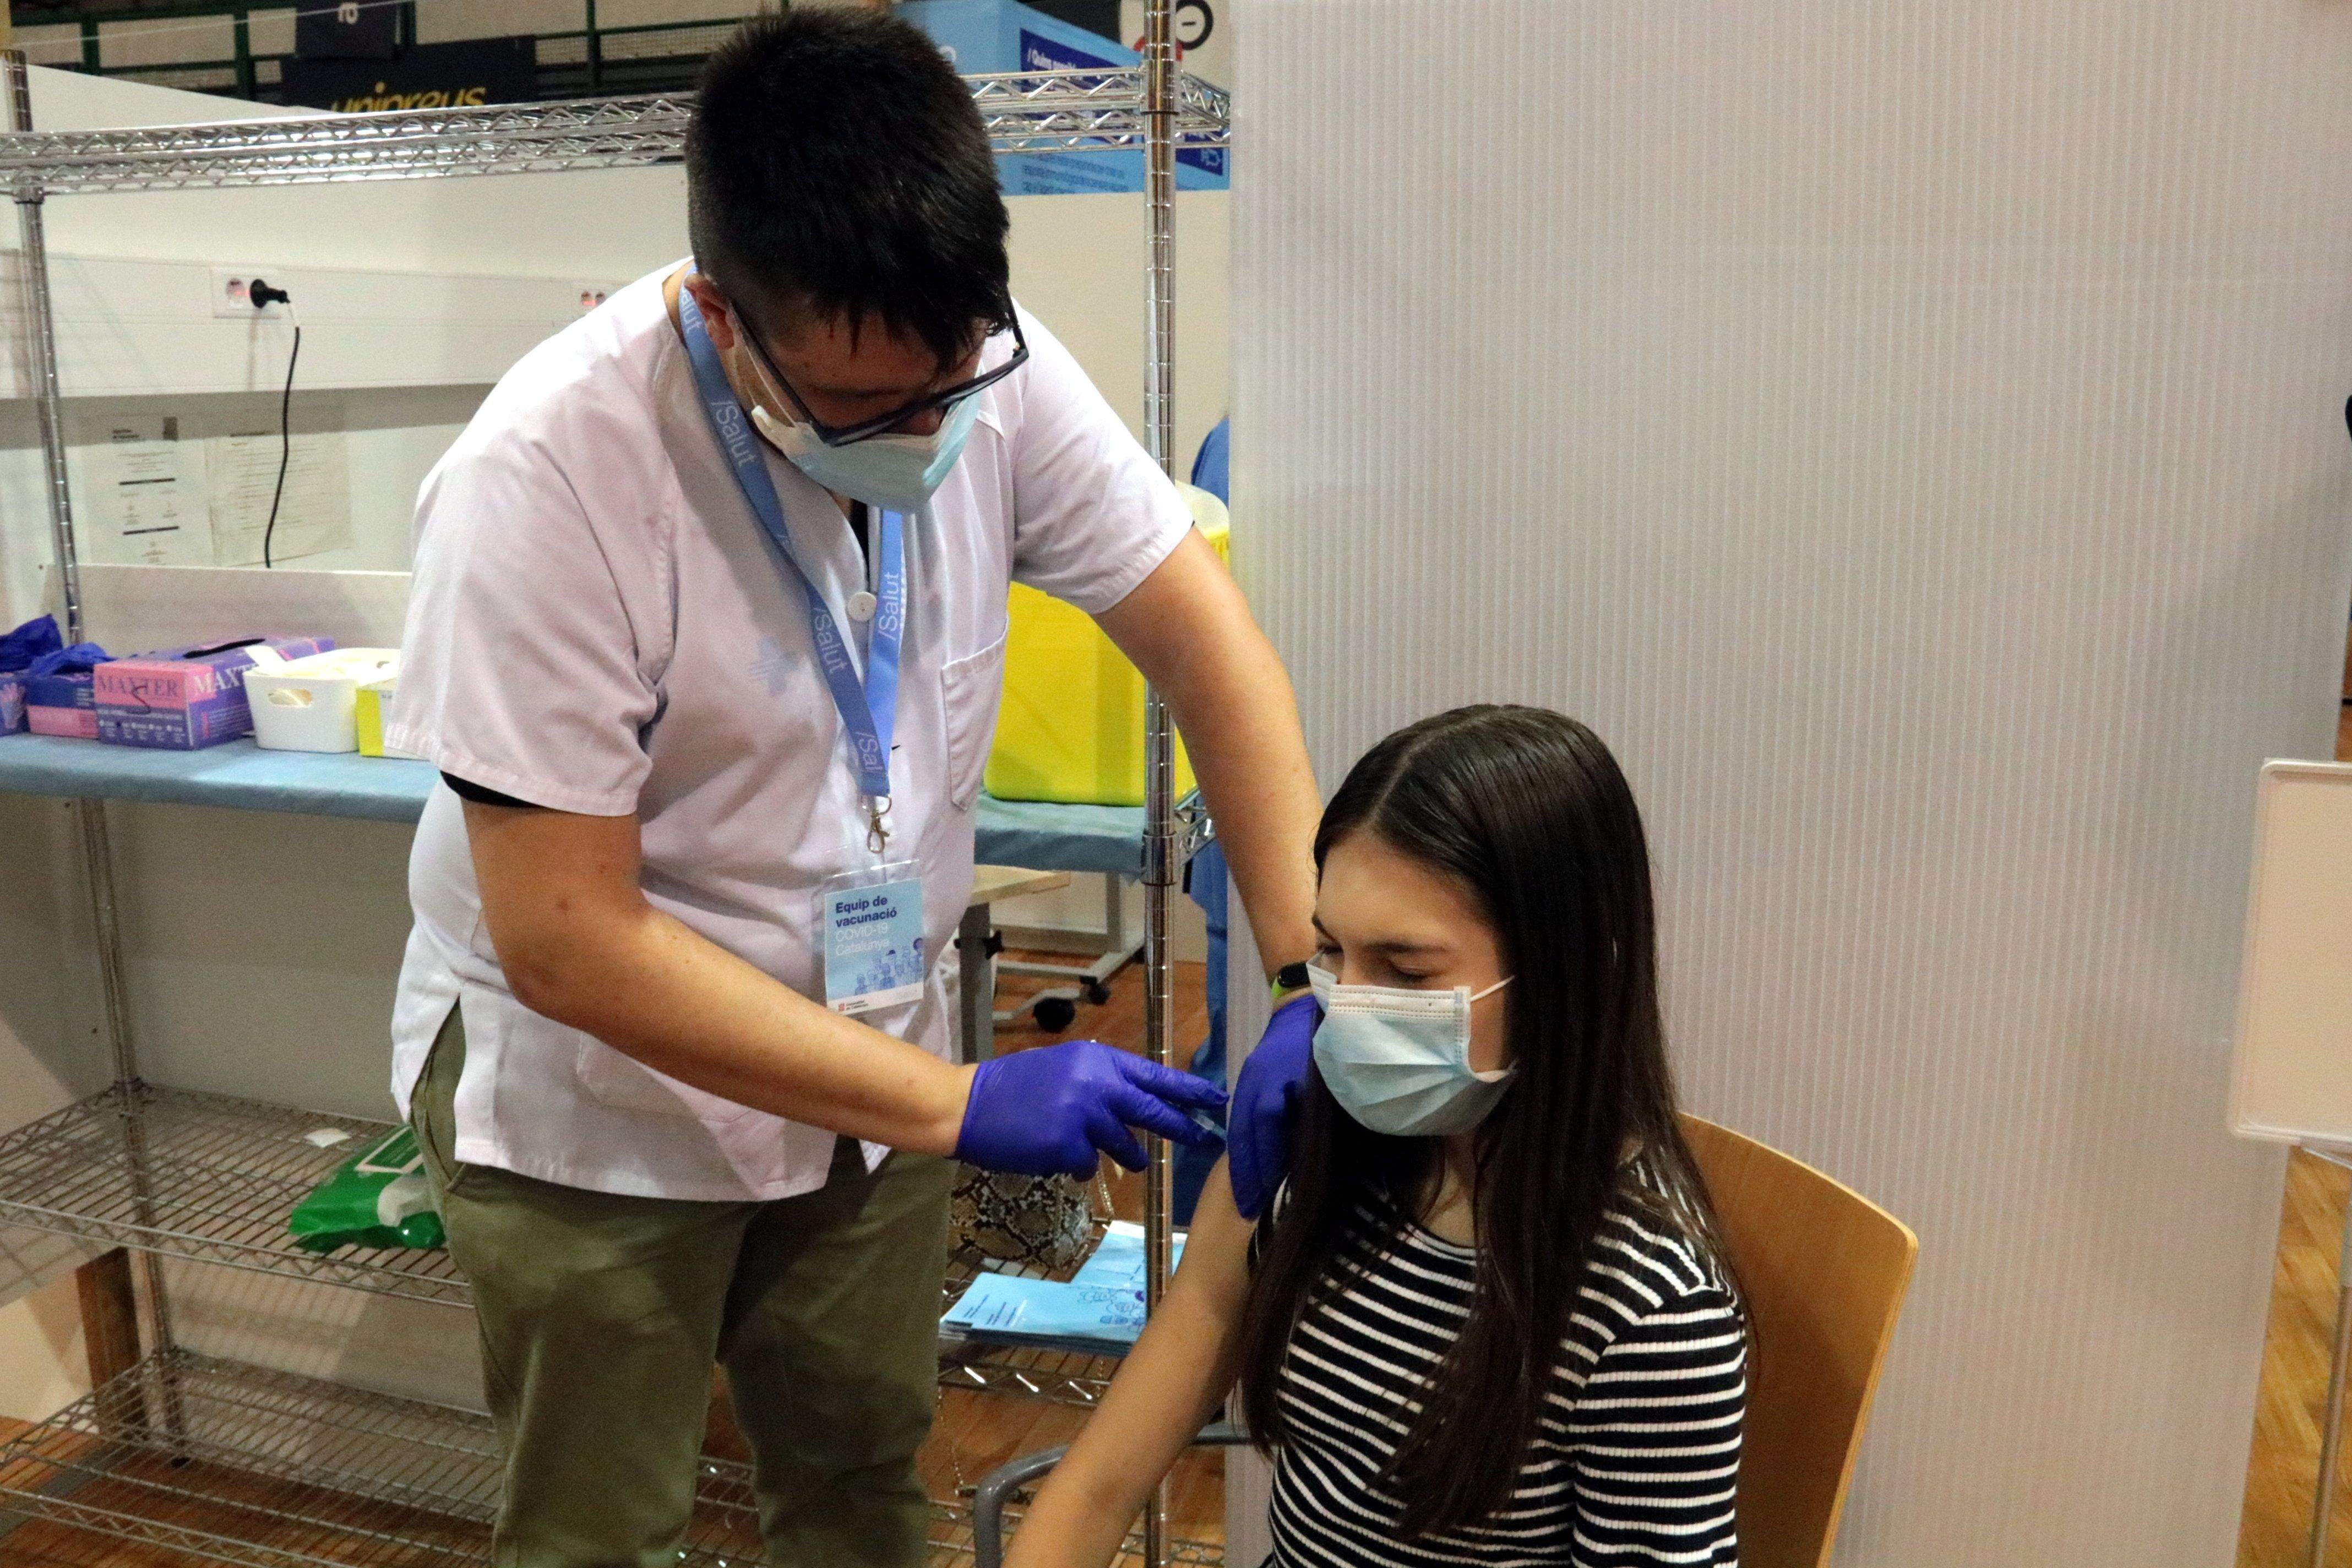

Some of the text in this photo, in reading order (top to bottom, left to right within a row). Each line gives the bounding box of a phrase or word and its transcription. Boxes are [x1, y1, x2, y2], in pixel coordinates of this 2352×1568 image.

[680, 287, 703, 334] alut
[710, 400, 756, 467] /Salut
[878, 571, 899, 641] /Salut
[813, 607, 848, 674] /Salut
[836, 895, 888, 914] Equip de
[836, 906, 897, 927] vacunació
[835, 938, 890, 956] Catalunya
[836, 922, 888, 942] COVID-19
